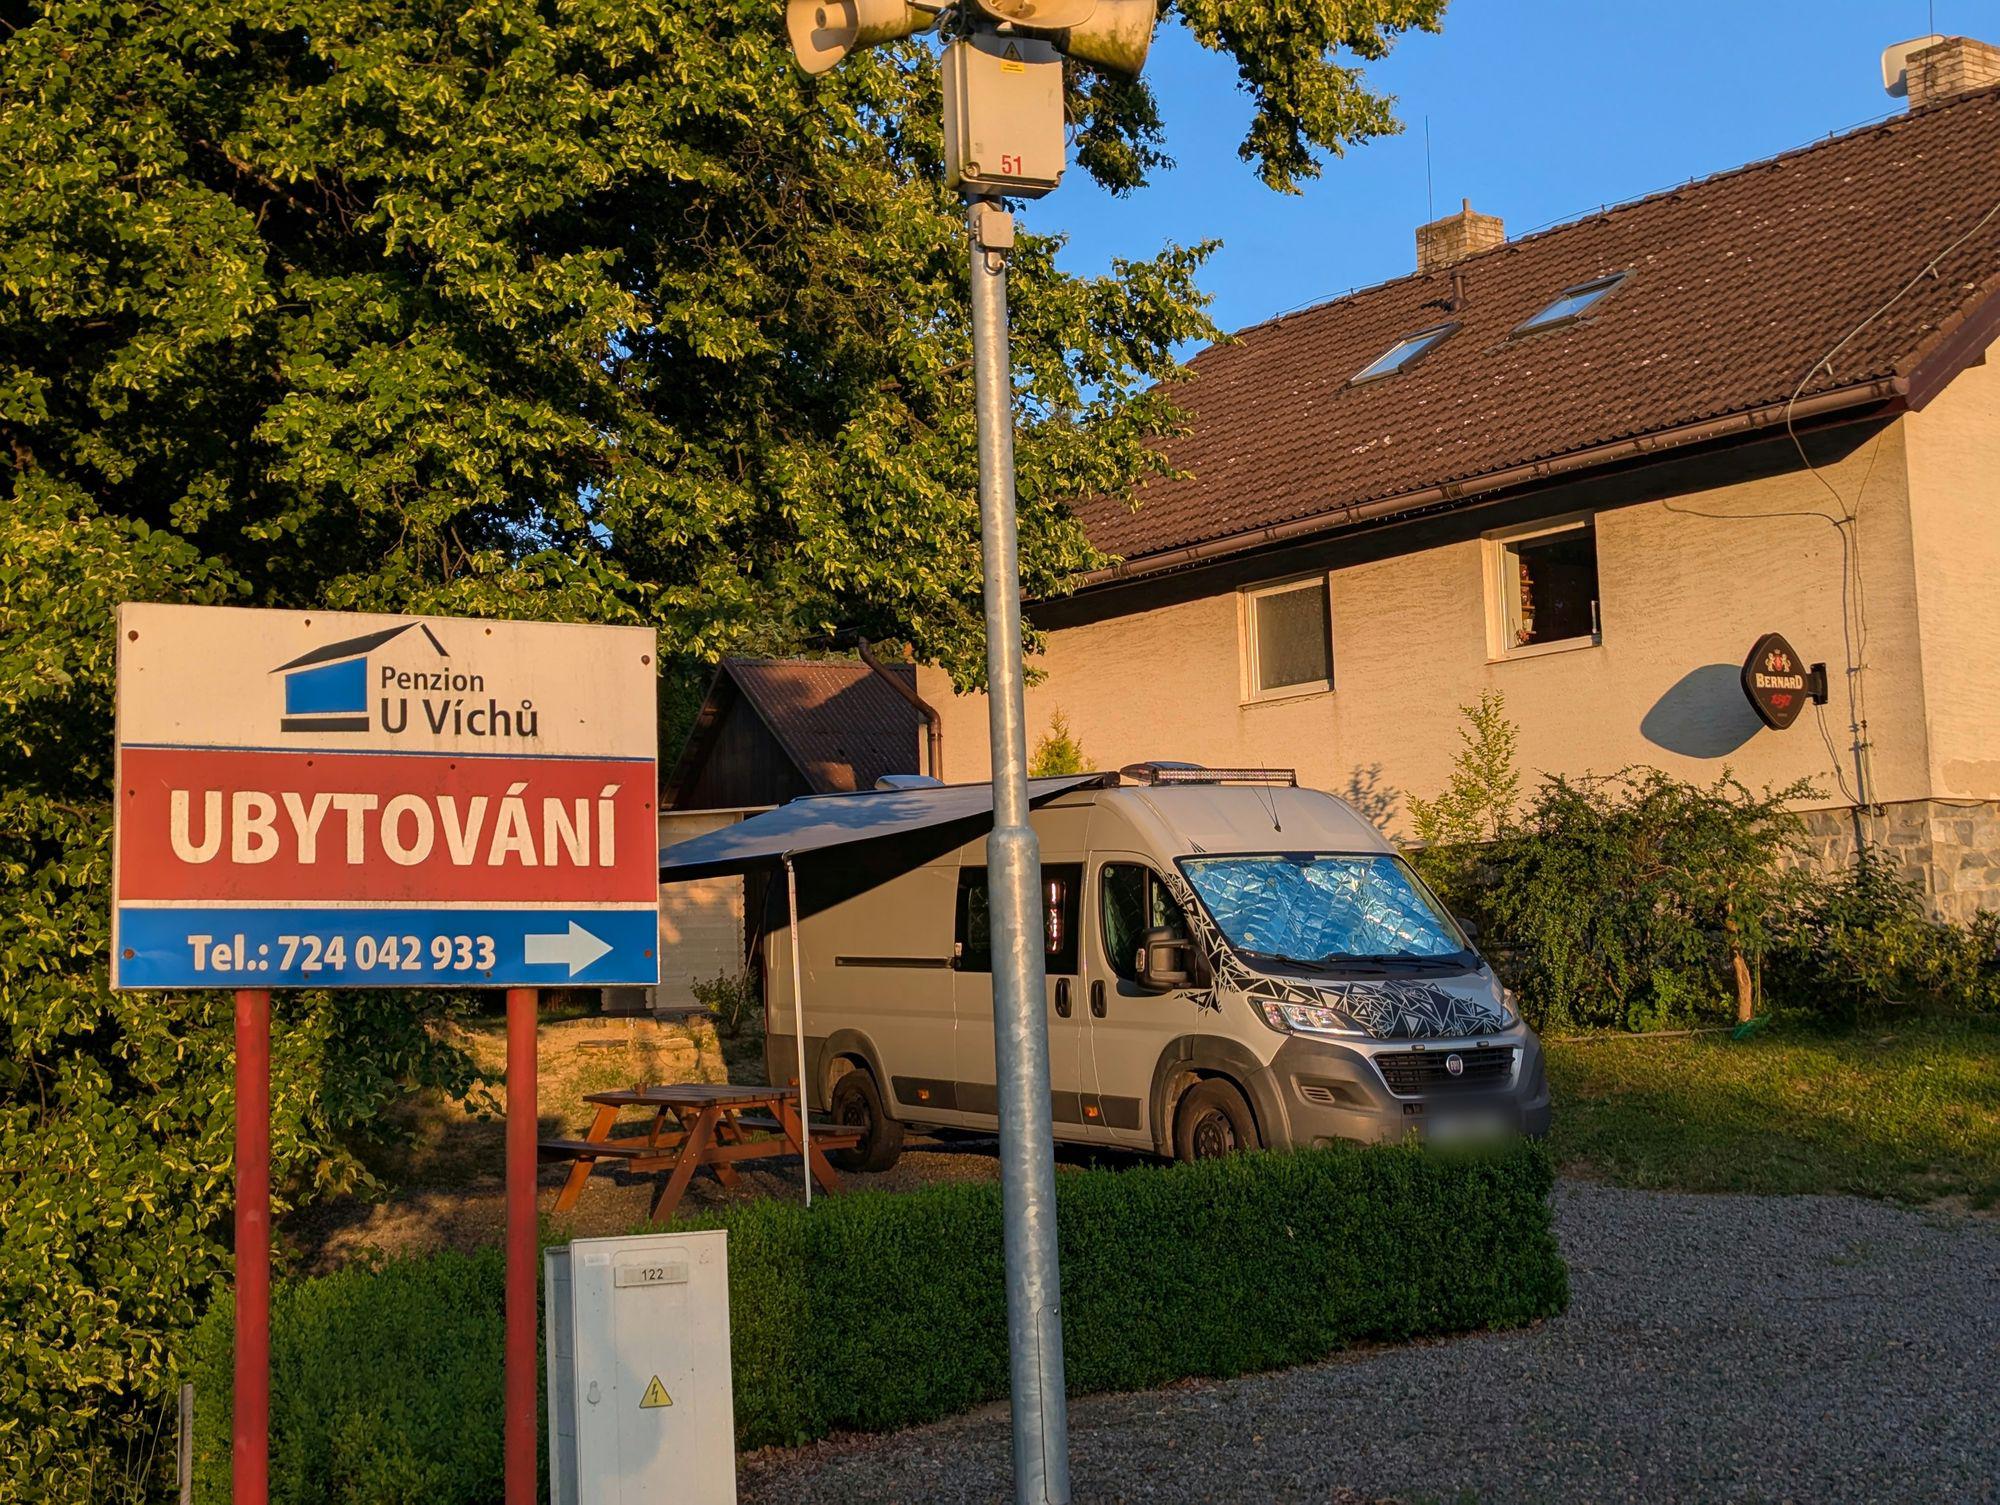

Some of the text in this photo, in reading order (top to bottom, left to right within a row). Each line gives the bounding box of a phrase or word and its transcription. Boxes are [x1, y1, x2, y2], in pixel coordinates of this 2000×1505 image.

[1002, 154, 1022, 175] 51
[381, 666, 484, 692] Penzion
[1755, 672, 1803, 690] BERNARD
[381, 697, 538, 737] U Víchů
[169, 781, 621, 867] UBYTOVÁNÍ
[187, 934, 496, 971] Tel.: 724 042 933
[641, 1268, 663, 1280] 122
